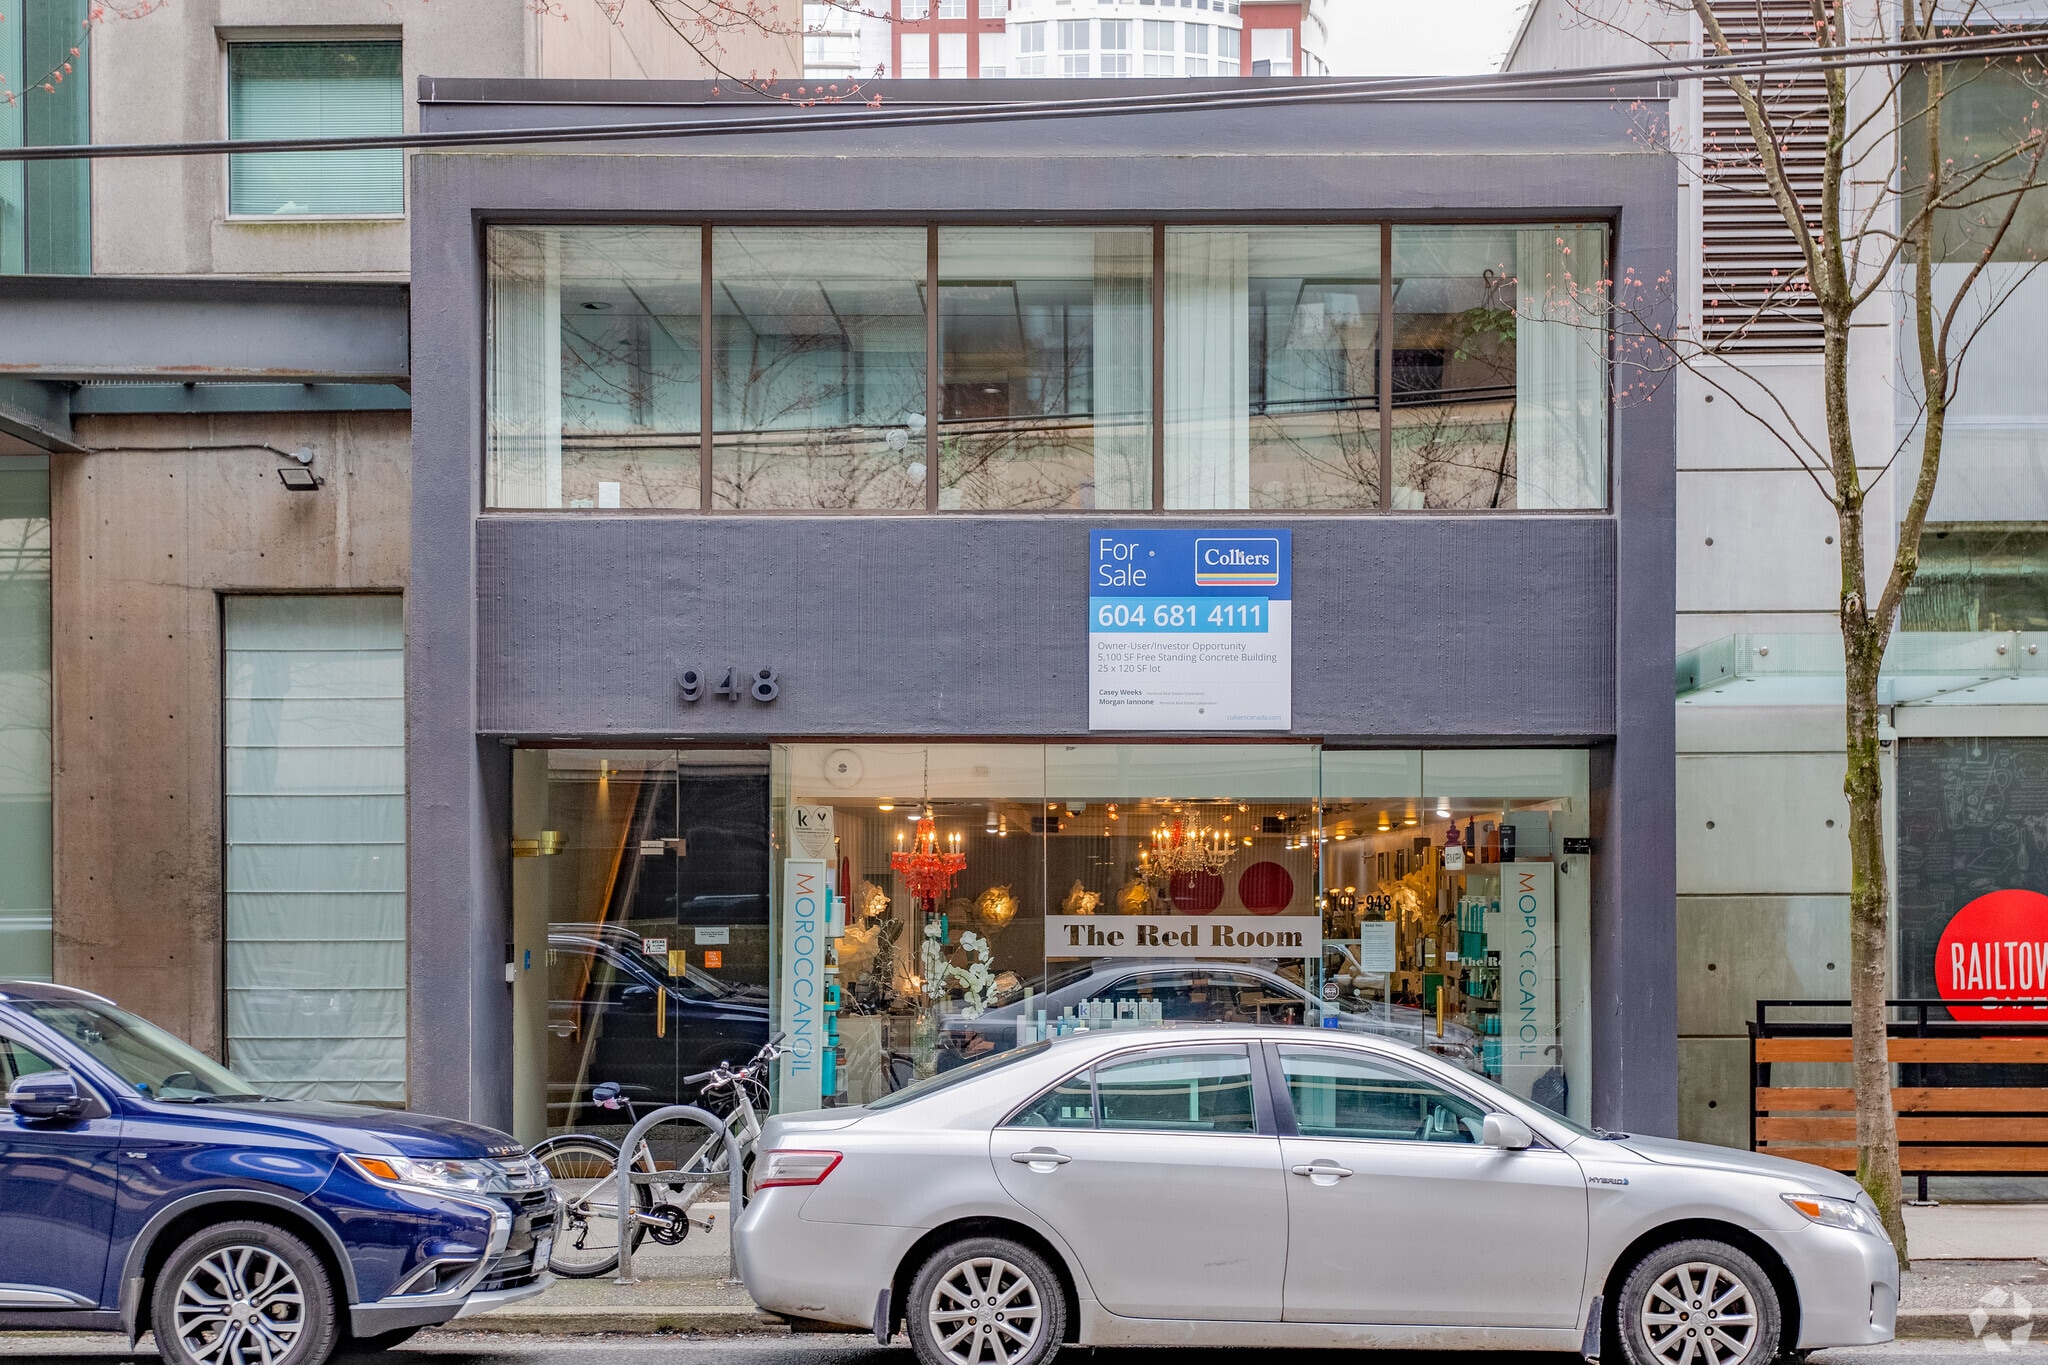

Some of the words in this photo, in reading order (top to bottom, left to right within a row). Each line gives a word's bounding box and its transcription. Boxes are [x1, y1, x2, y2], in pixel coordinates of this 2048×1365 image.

[1099, 538, 1140, 561] For
[1204, 548, 1270, 566] Colliers
[1098, 563, 1147, 586] Sale
[1098, 604, 1146, 627] 604
[1153, 604, 1196, 627] 681
[1207, 604, 1261, 627] 4111
[1097, 641, 1190, 650] Owner-User/Investor
[1192, 642, 1247, 652] Opportunity
[1097, 653, 1122, 663] 5,100
[1124, 653, 1134, 662] SF
[1136, 653, 1156, 662] Free
[1158, 652, 1197, 664] Standing
[1199, 653, 1239, 662] Concrete
[1242, 652, 1278, 664] Building
[1097, 664, 1108, 673] 25
[1118, 664, 1134, 673] 120
[1136, 664, 1147, 673] SF
[1149, 664, 1161, 673] lot
[678, 666, 780, 702] 948
[1098, 689, 1118, 697] Casey
[1332, 894, 1392, 912] 100-948
[1064, 924, 1124, 947] The
[1135, 924, 1200, 947] Red
[1210, 924, 1304, 948] Room
[1459, 956, 1486, 967] The
[792, 873, 815, 1076] MOROCCANOIL
[1589, 1176, 1622, 1185] HYBRID
